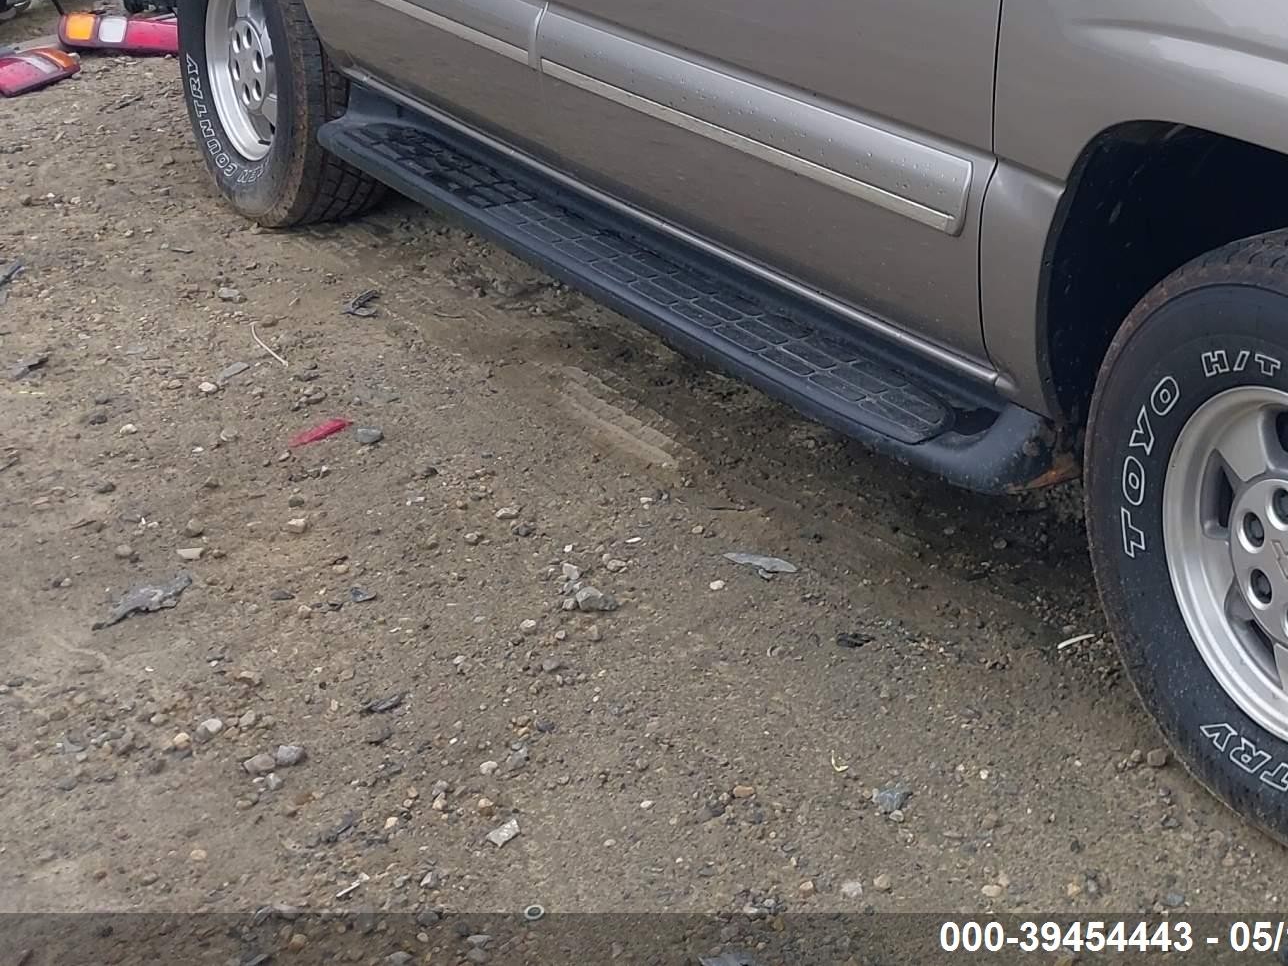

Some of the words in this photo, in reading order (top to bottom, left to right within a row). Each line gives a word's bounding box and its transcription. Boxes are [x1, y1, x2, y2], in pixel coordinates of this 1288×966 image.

[186, 53, 238, 177] COUNTRY
[1120, 376, 1180, 559] TOYO
[1201, 349, 1281, 377] H/T
